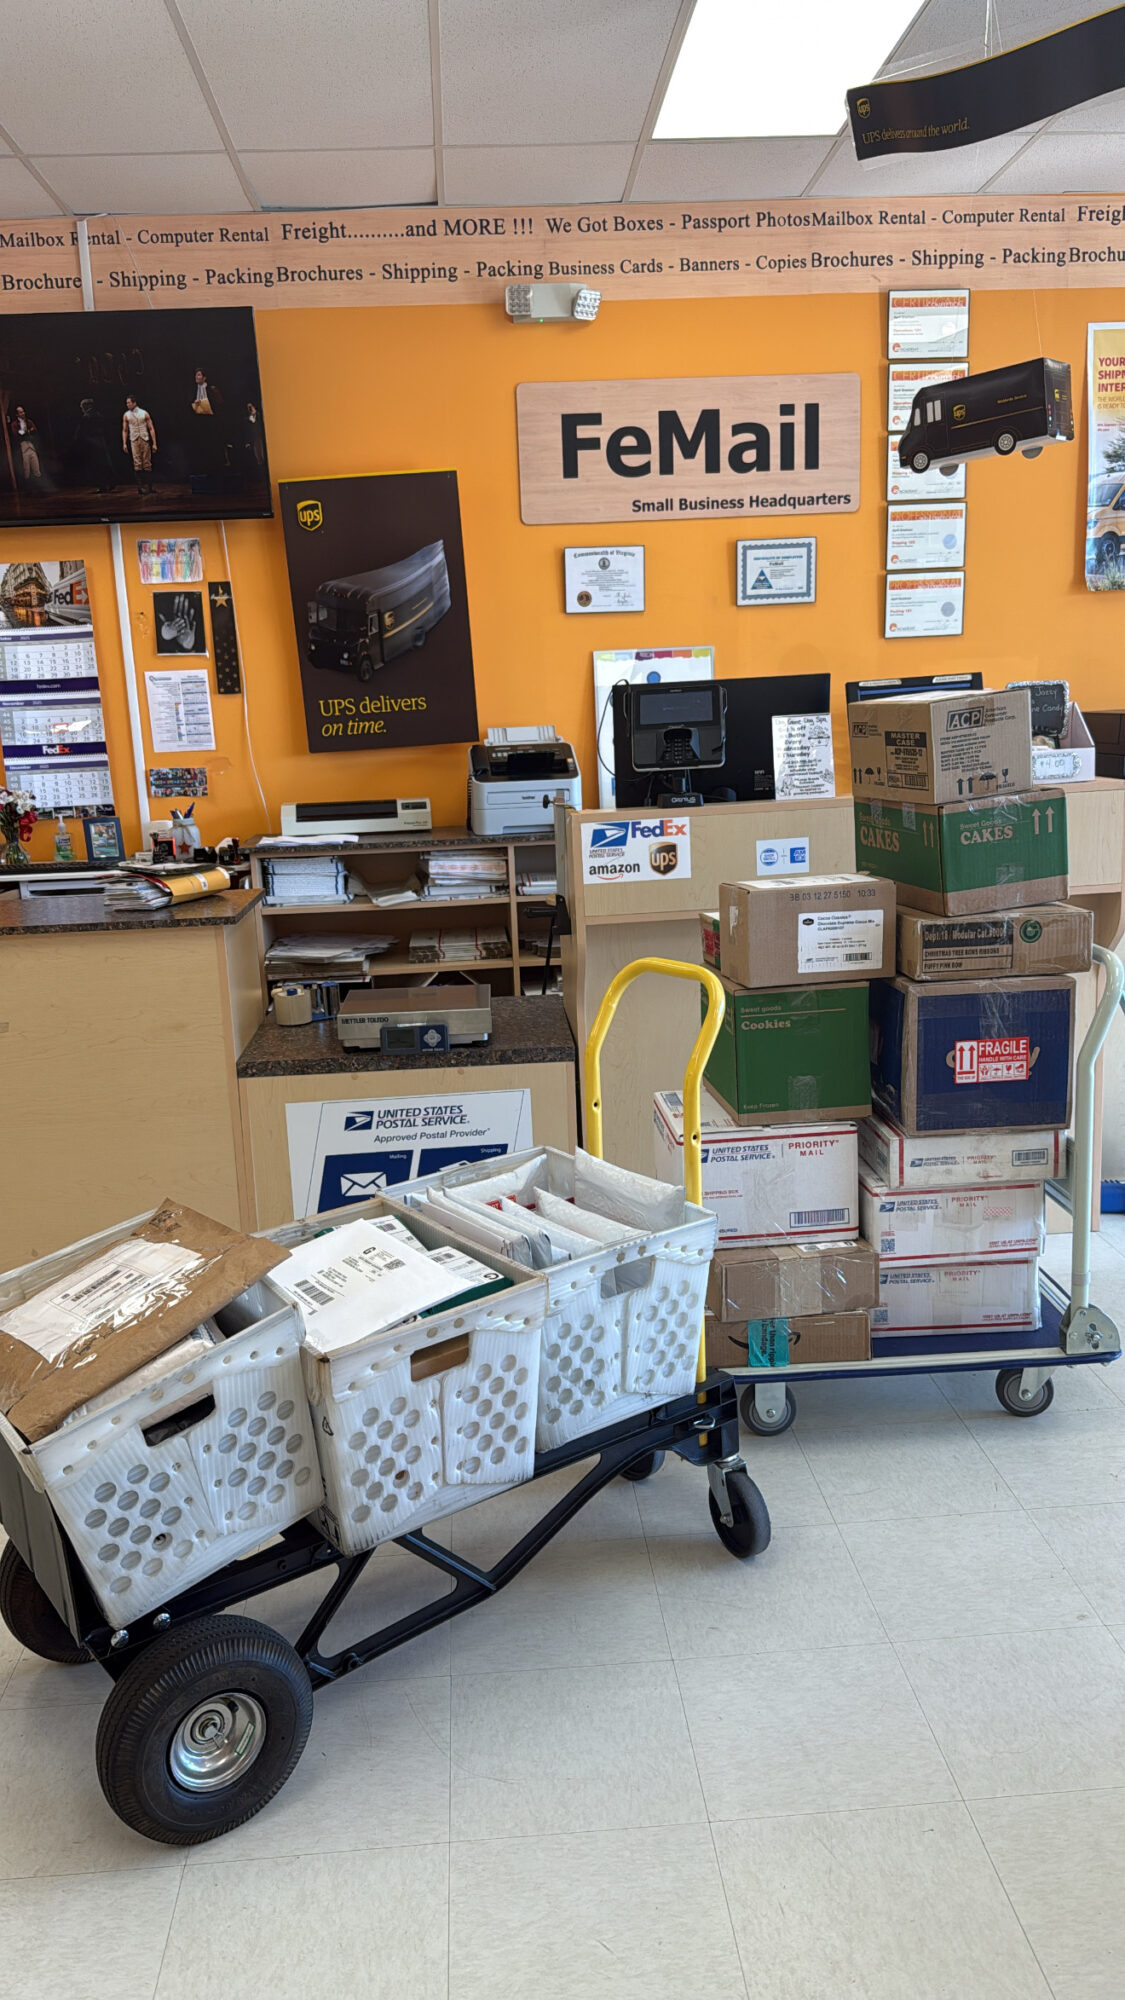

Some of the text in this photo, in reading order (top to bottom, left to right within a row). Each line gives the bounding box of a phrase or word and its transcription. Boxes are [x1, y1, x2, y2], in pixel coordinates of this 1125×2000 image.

[862, 117, 970, 144] UPS delivers around the world.
[546, 212, 810, 233] We Got Boxes Passport Photos
[812, 208, 1065, 227] Mailbox Rental Computer Rental
[1077, 206, 1125, 225] Freig
[444, 218, 506, 236] MORE
[513, 218, 534, 234] !!!
[0, 227, 269, 247] Mailbox Rntal Computer Rental
[548, 254, 807, 276] Business Cards Banners Copies
[811, 247, 1066, 269] Brochures Shipping Packing
[2, 266, 274, 291] Brochure Shipping Packing
[276, 260, 544, 283] Brochures Shipping Packing
[1098, 357, 1125, 367] YOUR
[561, 403, 819, 479] FeMail
[632, 493, 851, 513] Small Business Headquarters
[300, 508, 320, 526] ups
[318, 696, 427, 717] UPS delivers
[1042, 704, 1063, 716] Candy
[321, 720, 387, 737] on time.
[951, 711, 980, 728] ACP
[42, 745, 70, 754] FedEx
[631, 820, 687, 838] FedEx
[960, 822, 979, 830] Sweet
[860, 826, 900, 852] CAKES
[960, 826, 1014, 845] CAKES
[589, 863, 640, 875] amazon
[652, 852, 676, 870] ups
[802, 893, 811, 901] 03
[814, 892, 822, 900] 12
[834, 891, 851, 899] 5150
[857, 889, 876, 897] 10:33
[925, 950, 952, 958] CHRISTMAS
[741, 1019, 791, 1030] Cookies
[979, 1040, 1027, 1056] FRAGILE
[377, 1105, 463, 1119] UNITED STATES
[376, 1118, 419, 1129] POSTAL
[374, 1132, 417, 1144] Approved
[419, 1130, 447, 1140] Postal
[712, 1144, 769, 1154] UNITED STATES
[711, 1155, 738, 1163] POSTAL
